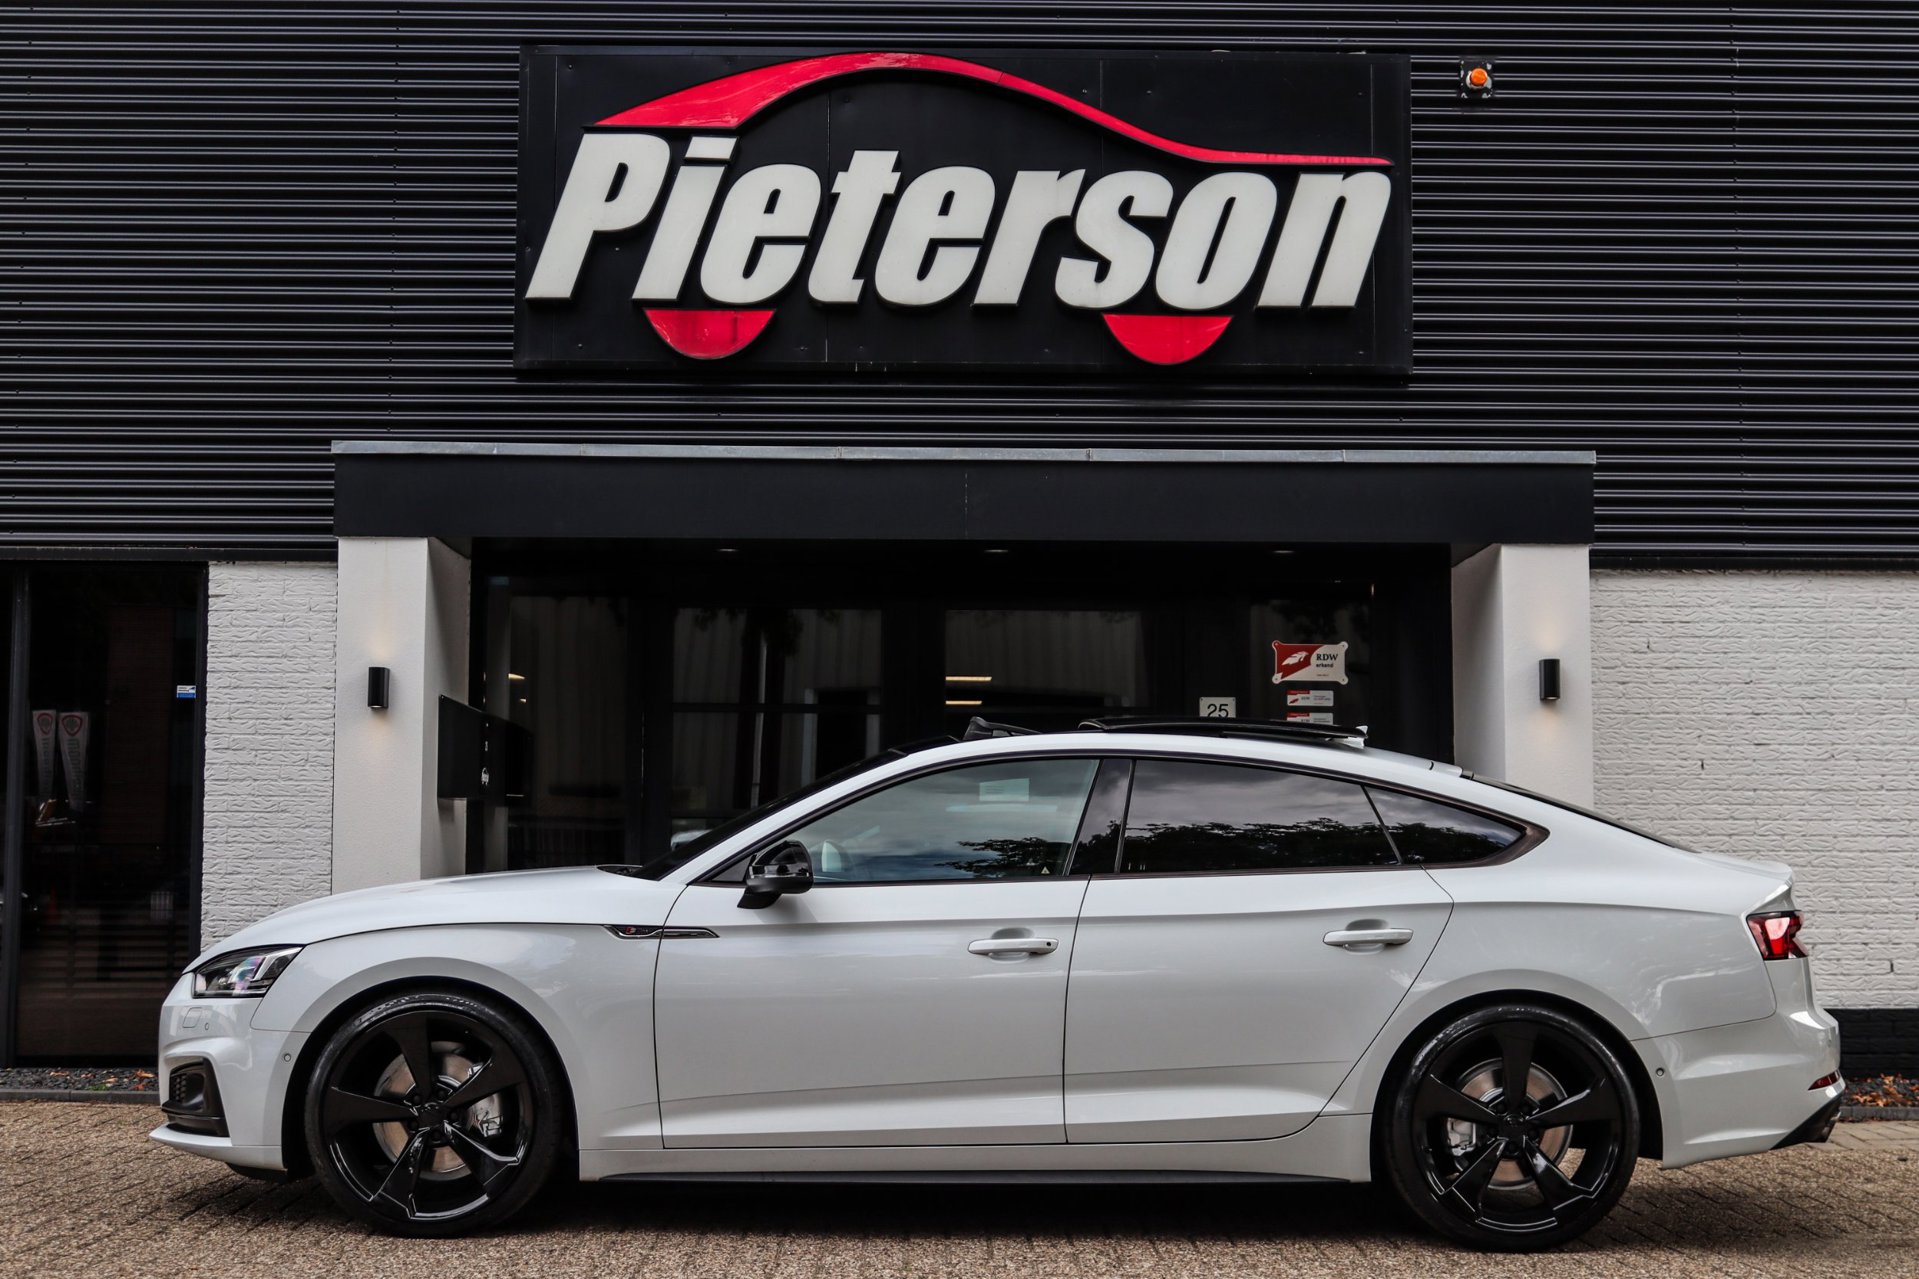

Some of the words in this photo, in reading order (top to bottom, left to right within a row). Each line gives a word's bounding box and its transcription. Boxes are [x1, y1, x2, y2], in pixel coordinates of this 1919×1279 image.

[525, 132, 1391, 311] Pieterson
[1316, 653, 1339, 661] RDW
[1207, 703, 1229, 717] 25
